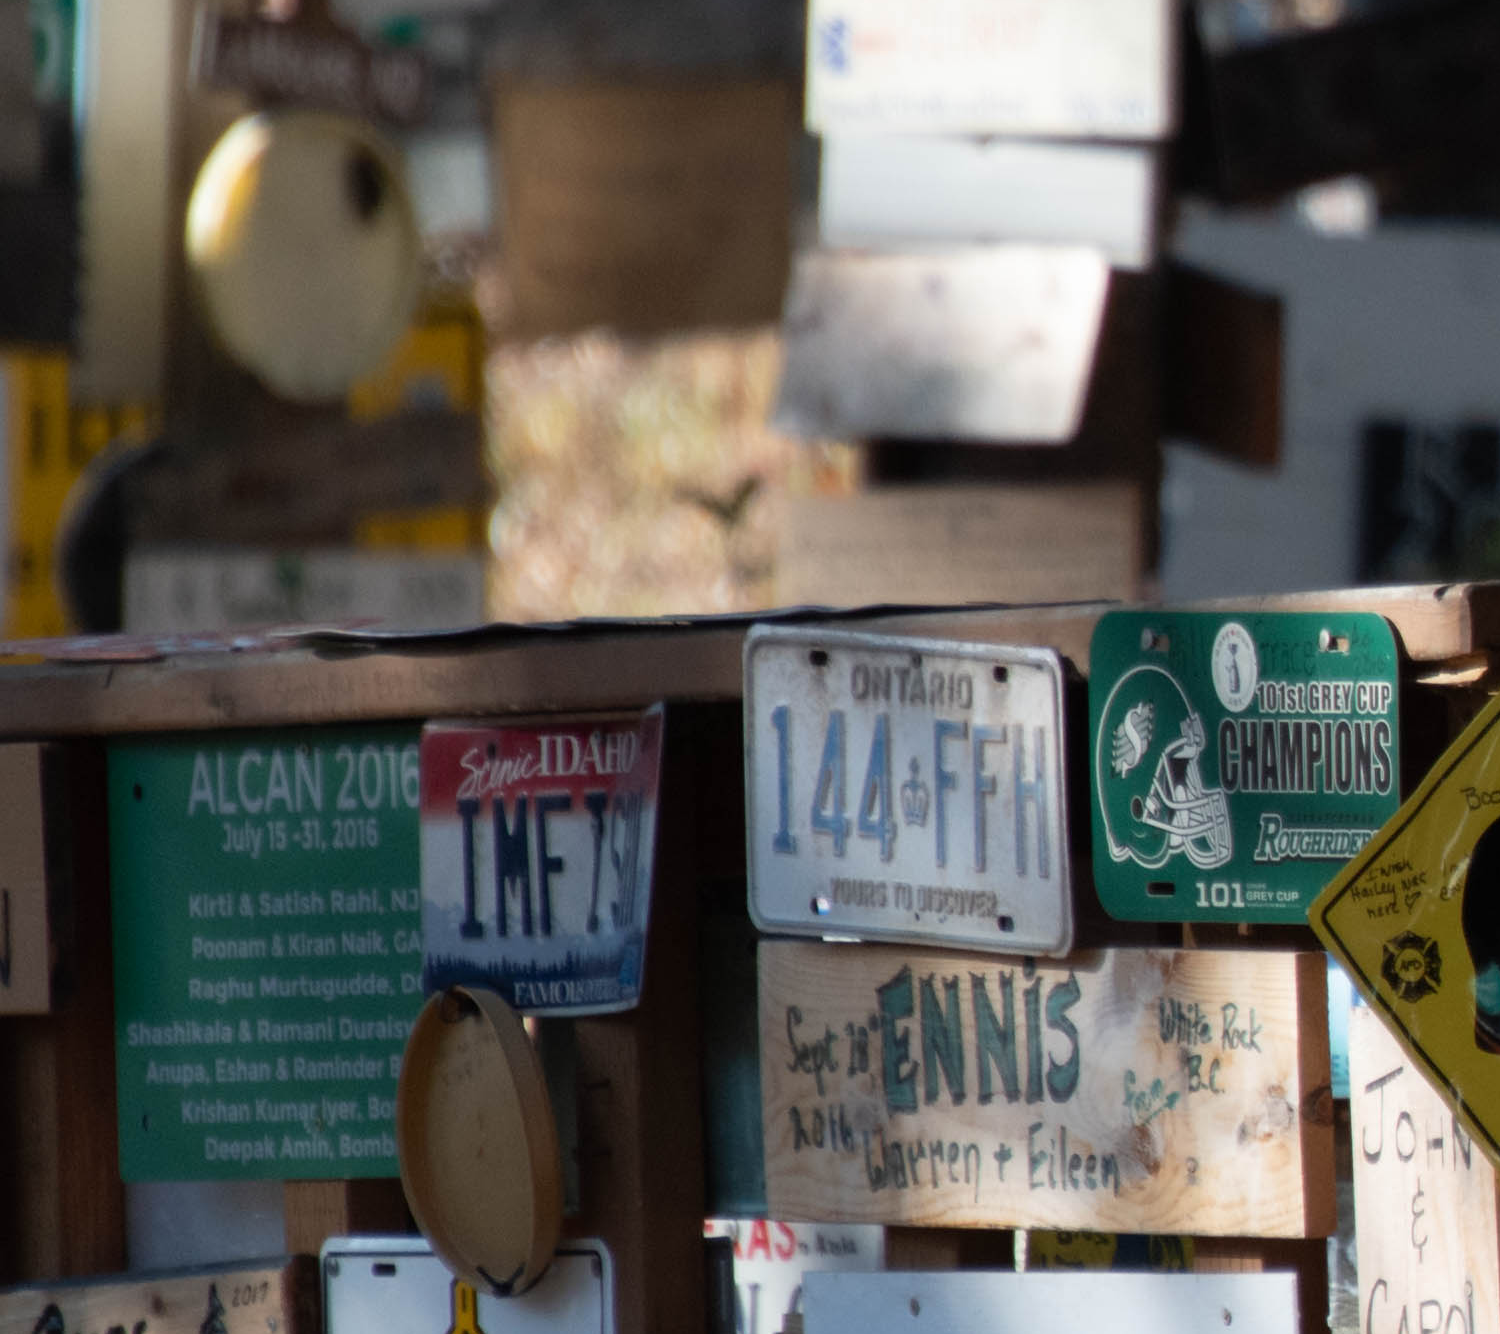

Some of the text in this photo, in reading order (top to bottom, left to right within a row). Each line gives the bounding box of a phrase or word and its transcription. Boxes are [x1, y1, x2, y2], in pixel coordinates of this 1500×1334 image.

[849, 662, 974, 711] ONTARIO
[1256, 681, 1393, 714] 101st GREY CUP
[457, 730, 639, 799] Scenic IDAHO
[1218, 719, 1393, 796] CHAMPIONS
[188, 743, 420, 816] ALCAN 2016
[769, 703, 896, 862] 144
[931, 715, 1051, 880] FFH
[222, 816, 380, 859] July 15 2016
[187, 886, 385, 918] Kirti Satish Rahi,
[830, 874, 916, 913] YOURS TO
[1195, 882, 1244, 908] 101
[191, 928, 389, 961] Poonam Kiran Naik,
[187, 978, 255, 1005] Raghu
[127, 1018, 334, 1047] Shashikala Ramani
[1157, 996, 1263, 1054] White Rock
[146, 1053, 385, 1088] Anupa, Eshan Raminder
[182, 1099, 250, 1125] Krishan
[204, 1132, 334, 1167] Deepak Amin,
[1027, 1120, 1121, 1198] Eileen
